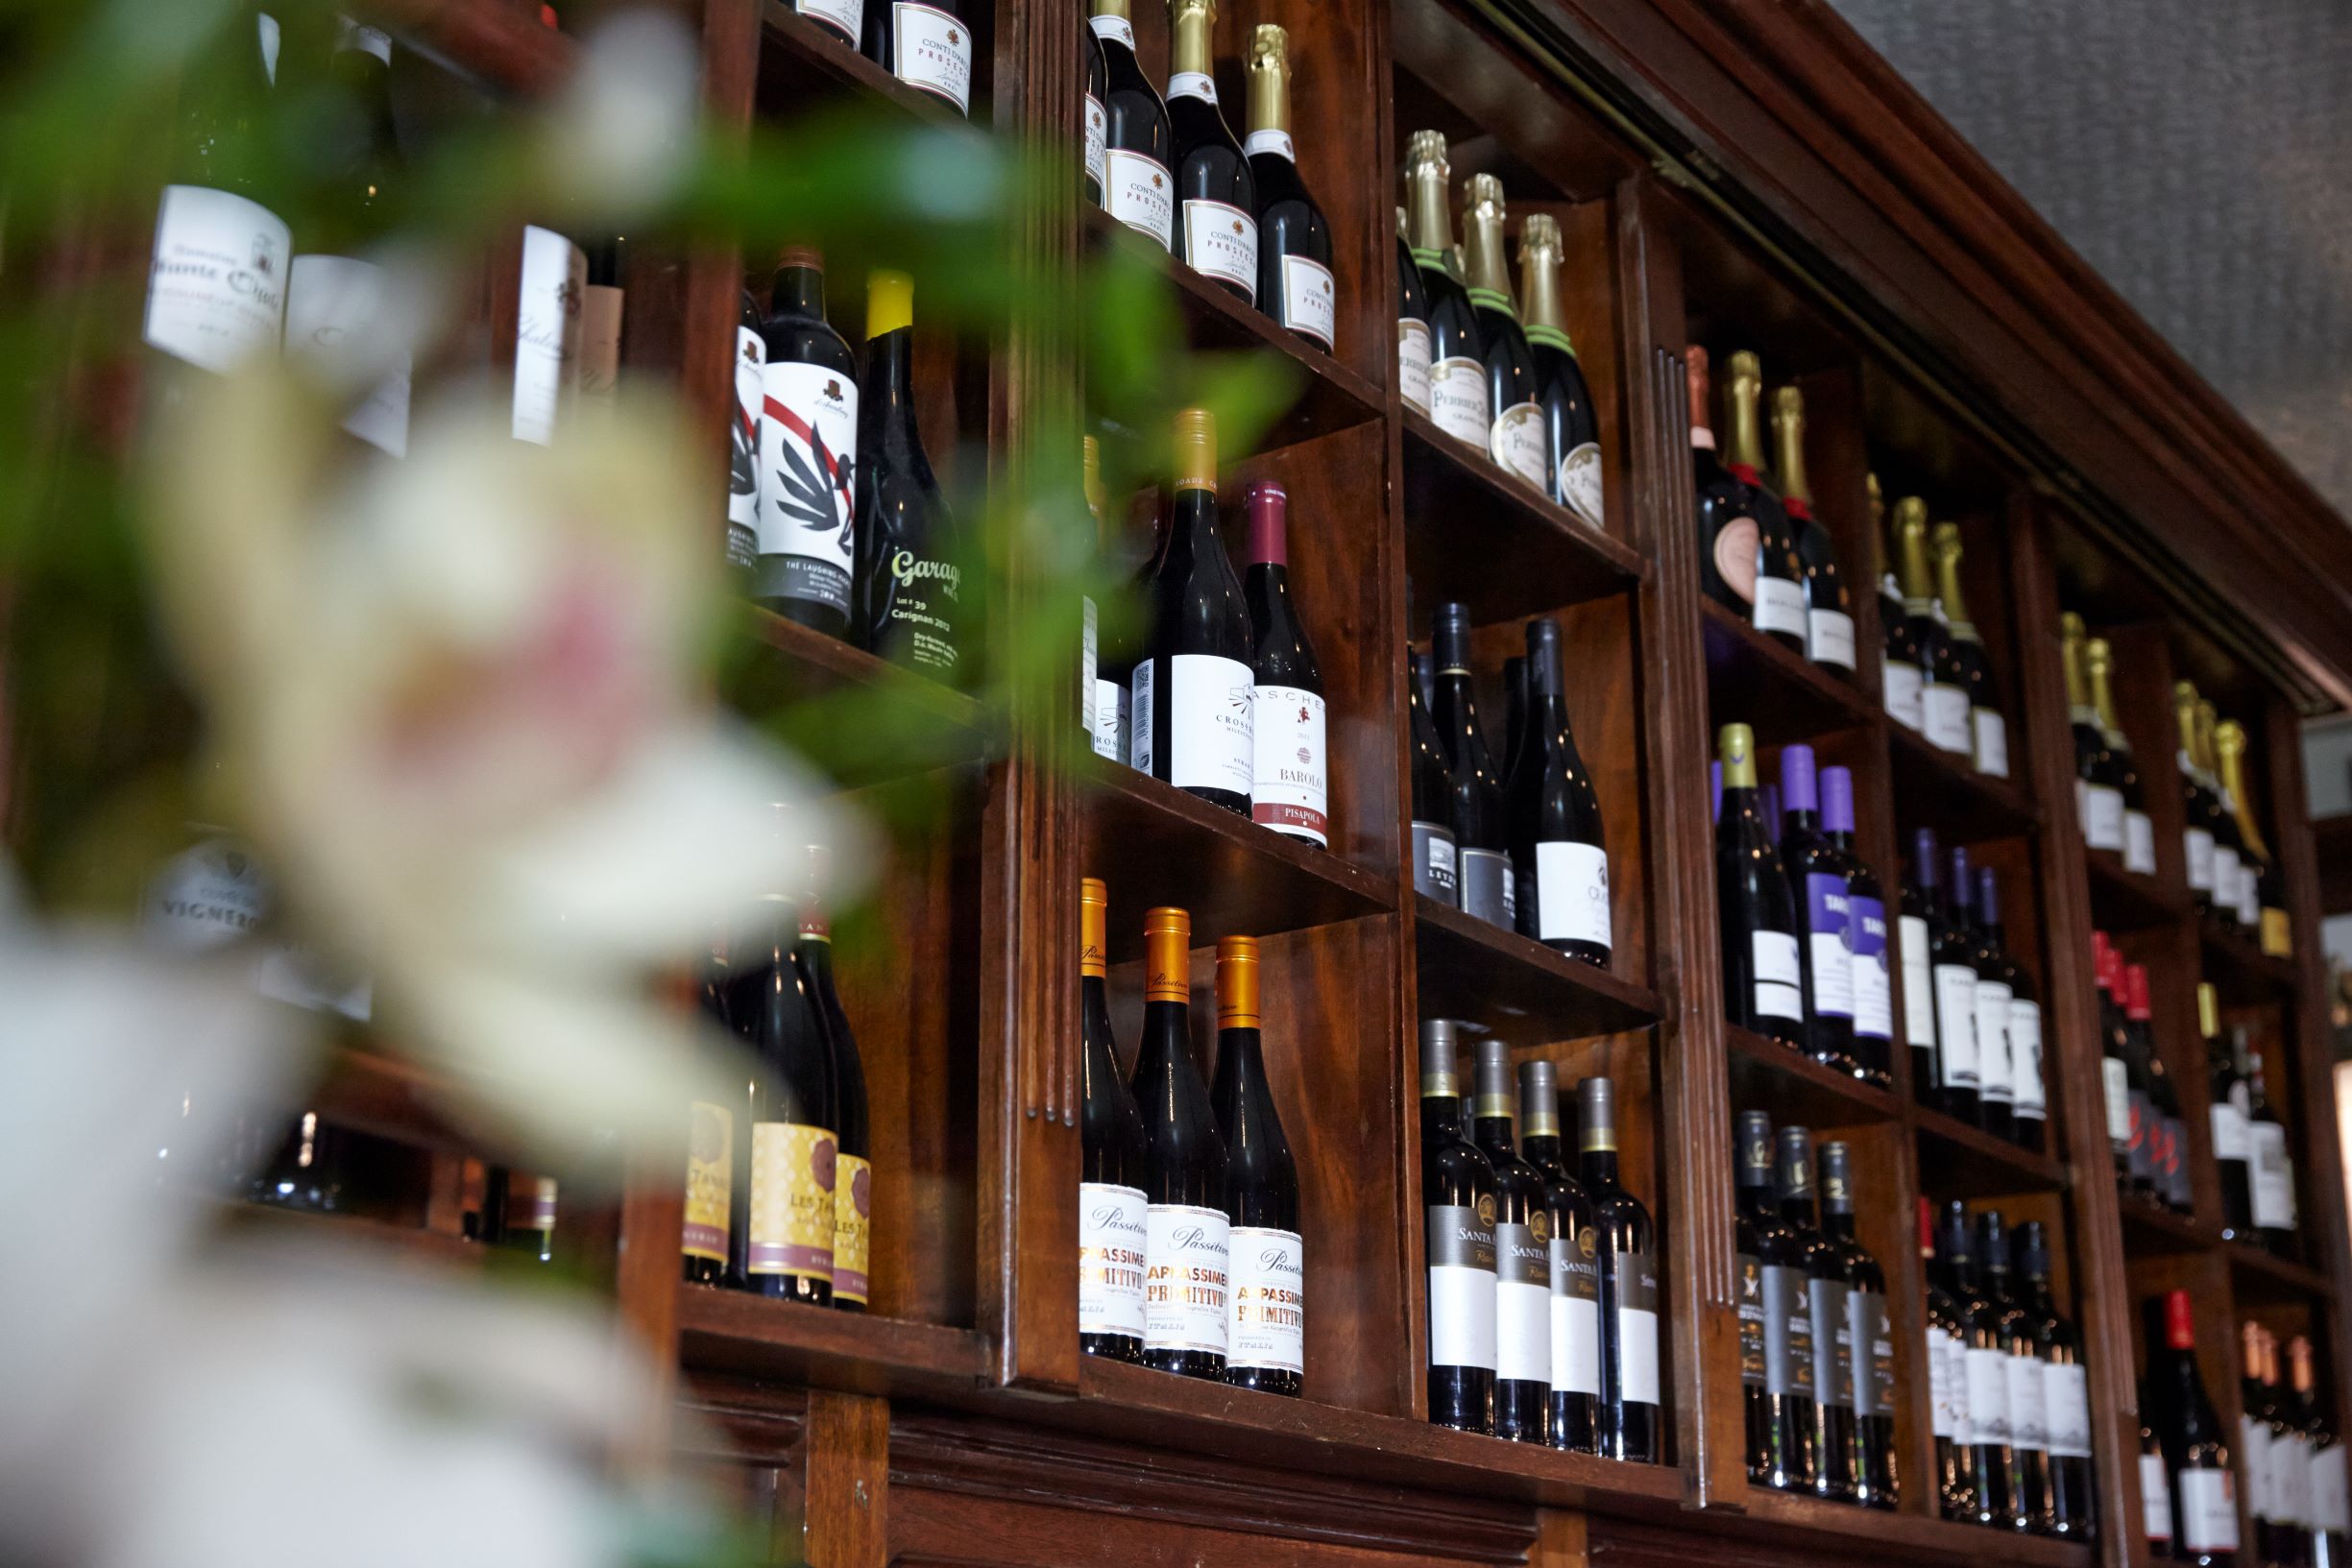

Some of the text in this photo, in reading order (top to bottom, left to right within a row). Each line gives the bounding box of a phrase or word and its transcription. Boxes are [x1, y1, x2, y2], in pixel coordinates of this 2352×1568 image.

[918, 48, 968, 82] PROSECC
[1127, 191, 1171, 222] PROSECC
[1210, 230, 1236, 246] CONTI
[786, 561, 800, 571] THE
[914, 600, 927, 611] 39
[891, 609, 934, 626] Carignan
[1252, 690, 1326, 712] ASCHE
[1280, 768, 1322, 789] BAROLO
[1285, 808, 1321, 824] PISAPOLA
[790, 1193, 814, 1209] LES
[1459, 1227, 1491, 1244] SANTA
[1511, 1244, 1545, 1261] SANTA
